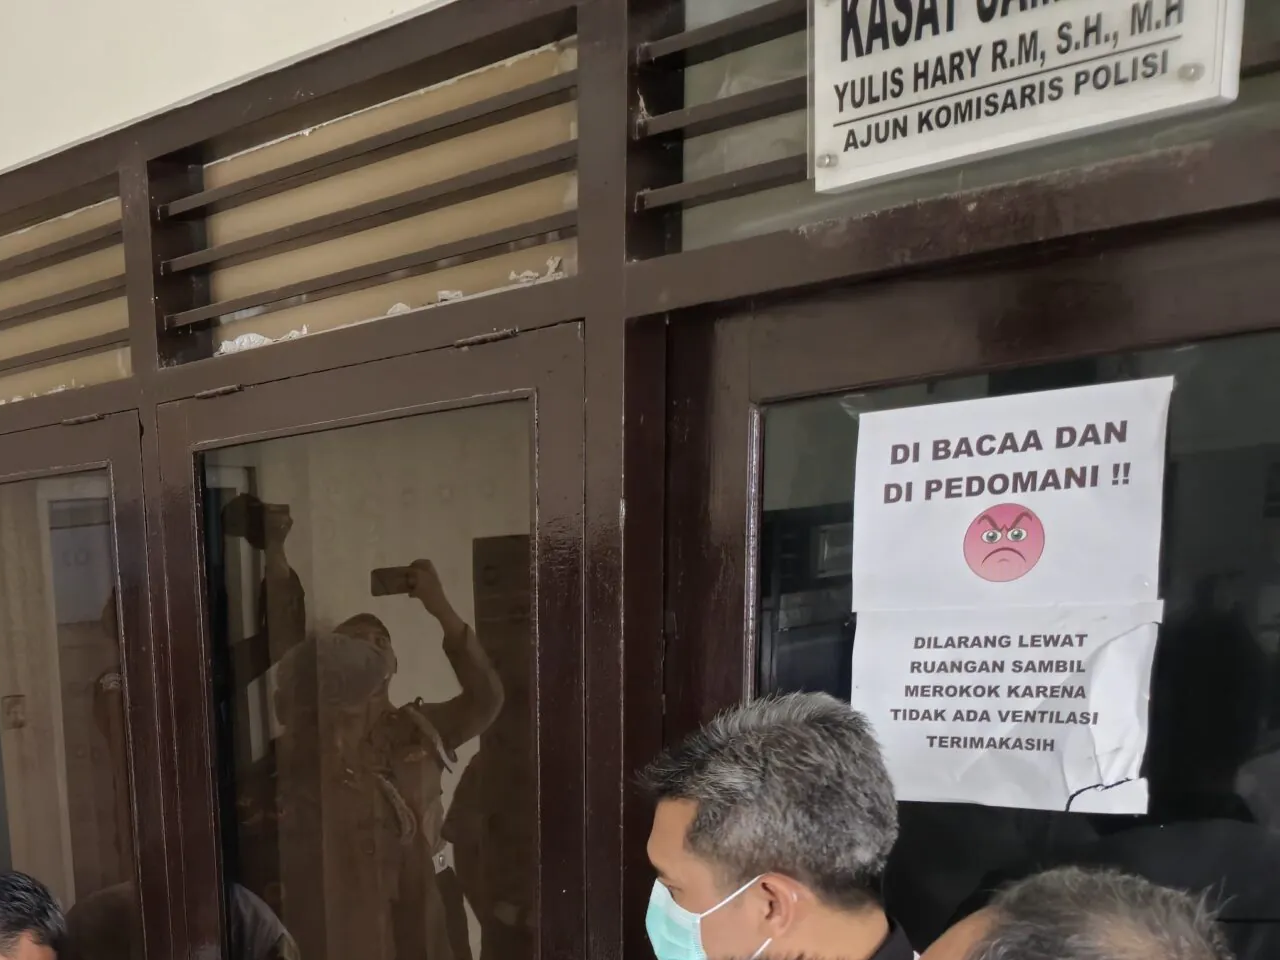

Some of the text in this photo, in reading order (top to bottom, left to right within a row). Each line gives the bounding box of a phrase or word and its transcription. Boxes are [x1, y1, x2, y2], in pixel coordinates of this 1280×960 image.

[834, 67, 904, 113] YULIS
[913, 44, 983, 93] HARY
[991, 29, 1046, 72] R.M,
[1130, 0, 1185, 36] M.H
[843, 50, 1169, 152] AJUN KOMISARIS POLISI
[890, 420, 1129, 465] DI BACAA DAN
[883, 462, 1132, 504] DI PEDOMANI !!
[913, 634, 1088, 650] DILARANG LEWAT
[910, 659, 1087, 674] RUANGAN SAMBIL
[904, 685, 1087, 699] MEROKOK KARENA
[890, 708, 1099, 726] TIDAK ADA VENTILASI
[926, 736, 1055, 752] TERIMAKASIH
